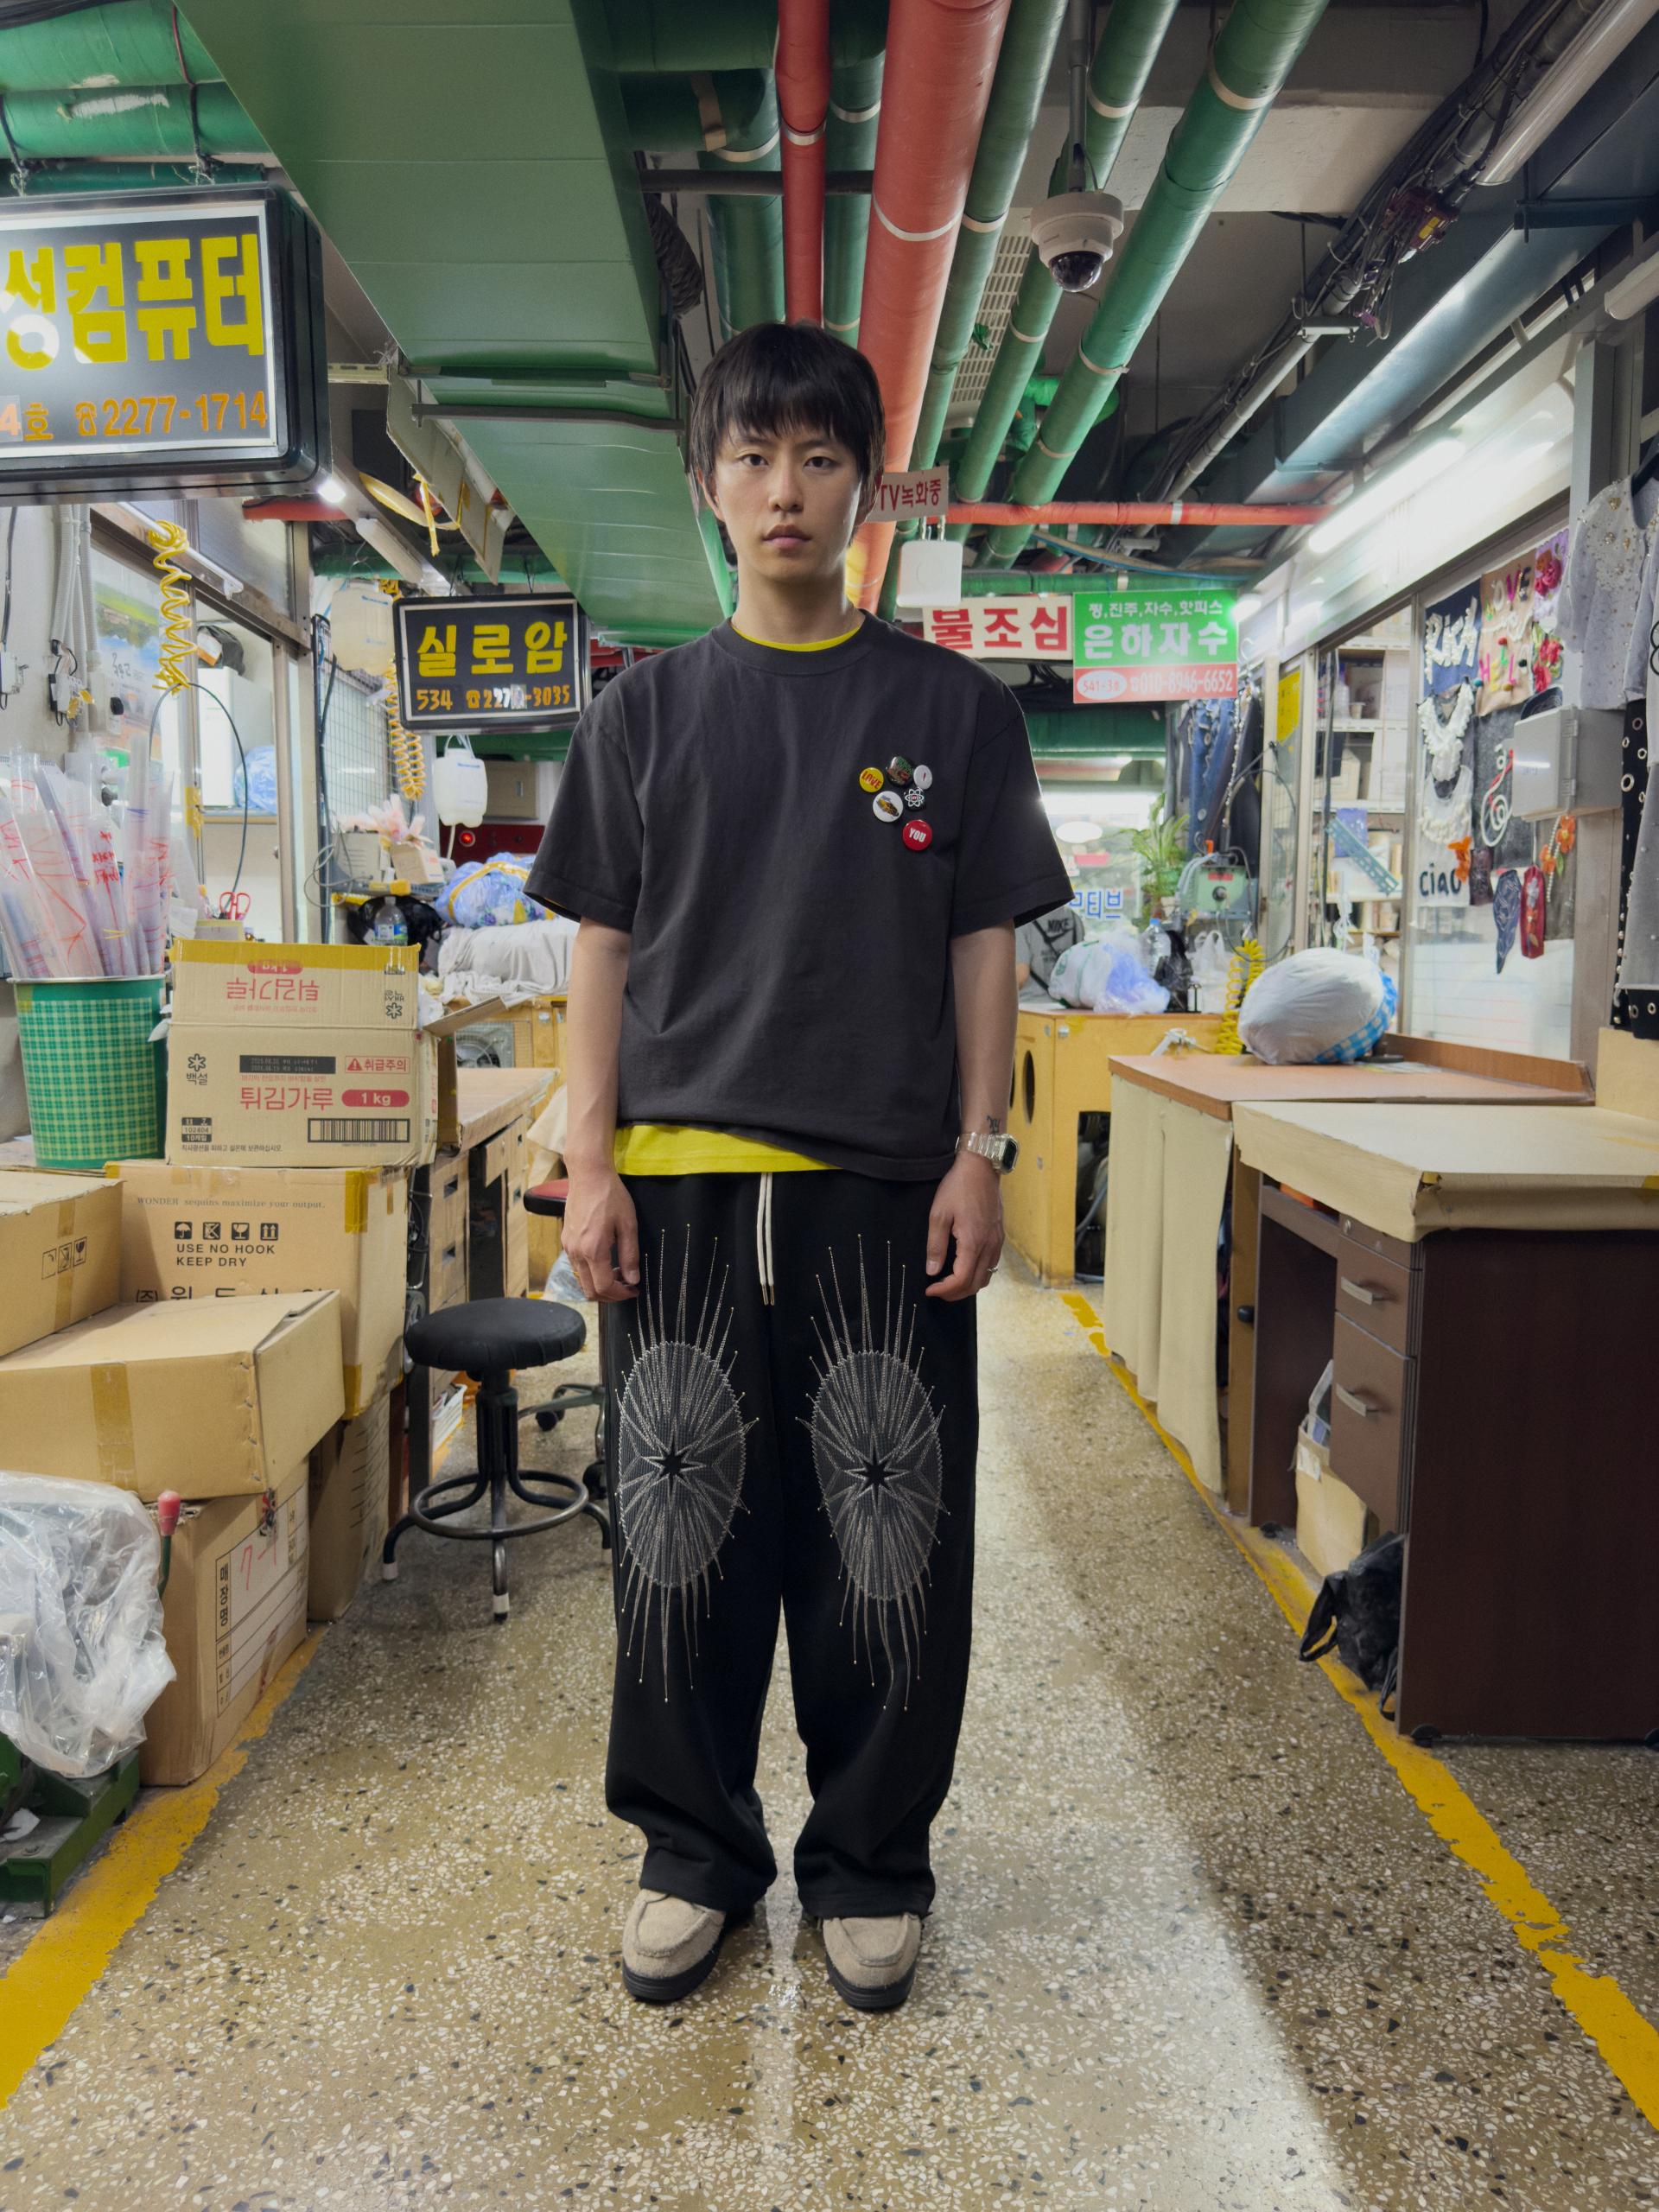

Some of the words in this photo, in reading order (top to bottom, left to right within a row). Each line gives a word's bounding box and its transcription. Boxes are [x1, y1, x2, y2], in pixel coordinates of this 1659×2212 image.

[103, 391, 268, 435] 2277-1714
[931, 607, 1068, 650] 불조심
[1084, 621, 1229, 659] 은하자수
[417, 621, 568, 677] 실로암
[416, 689, 453, 710] 534
[909, 828, 926, 842] YOU
[1048, 918, 1070, 932] NIKE
[364, 1058, 407, 1071] 취급주의
[186, 1072, 207, 1085] 백설
[239, 1087, 334, 1110] 튀김가루
[361, 1093, 368, 1103] 1
[373, 1093, 391, 1106] kg
[221, 1198, 266, 1207] maximize
[269, 1200, 289, 1209] your
[176, 1243, 204, 1253] USE
[209, 1244, 229, 1254] NO
[235, 1244, 275, 1254] HOOK
[176, 1256, 213, 1266] KEEP
[219, 1257, 247, 1267] DRY
